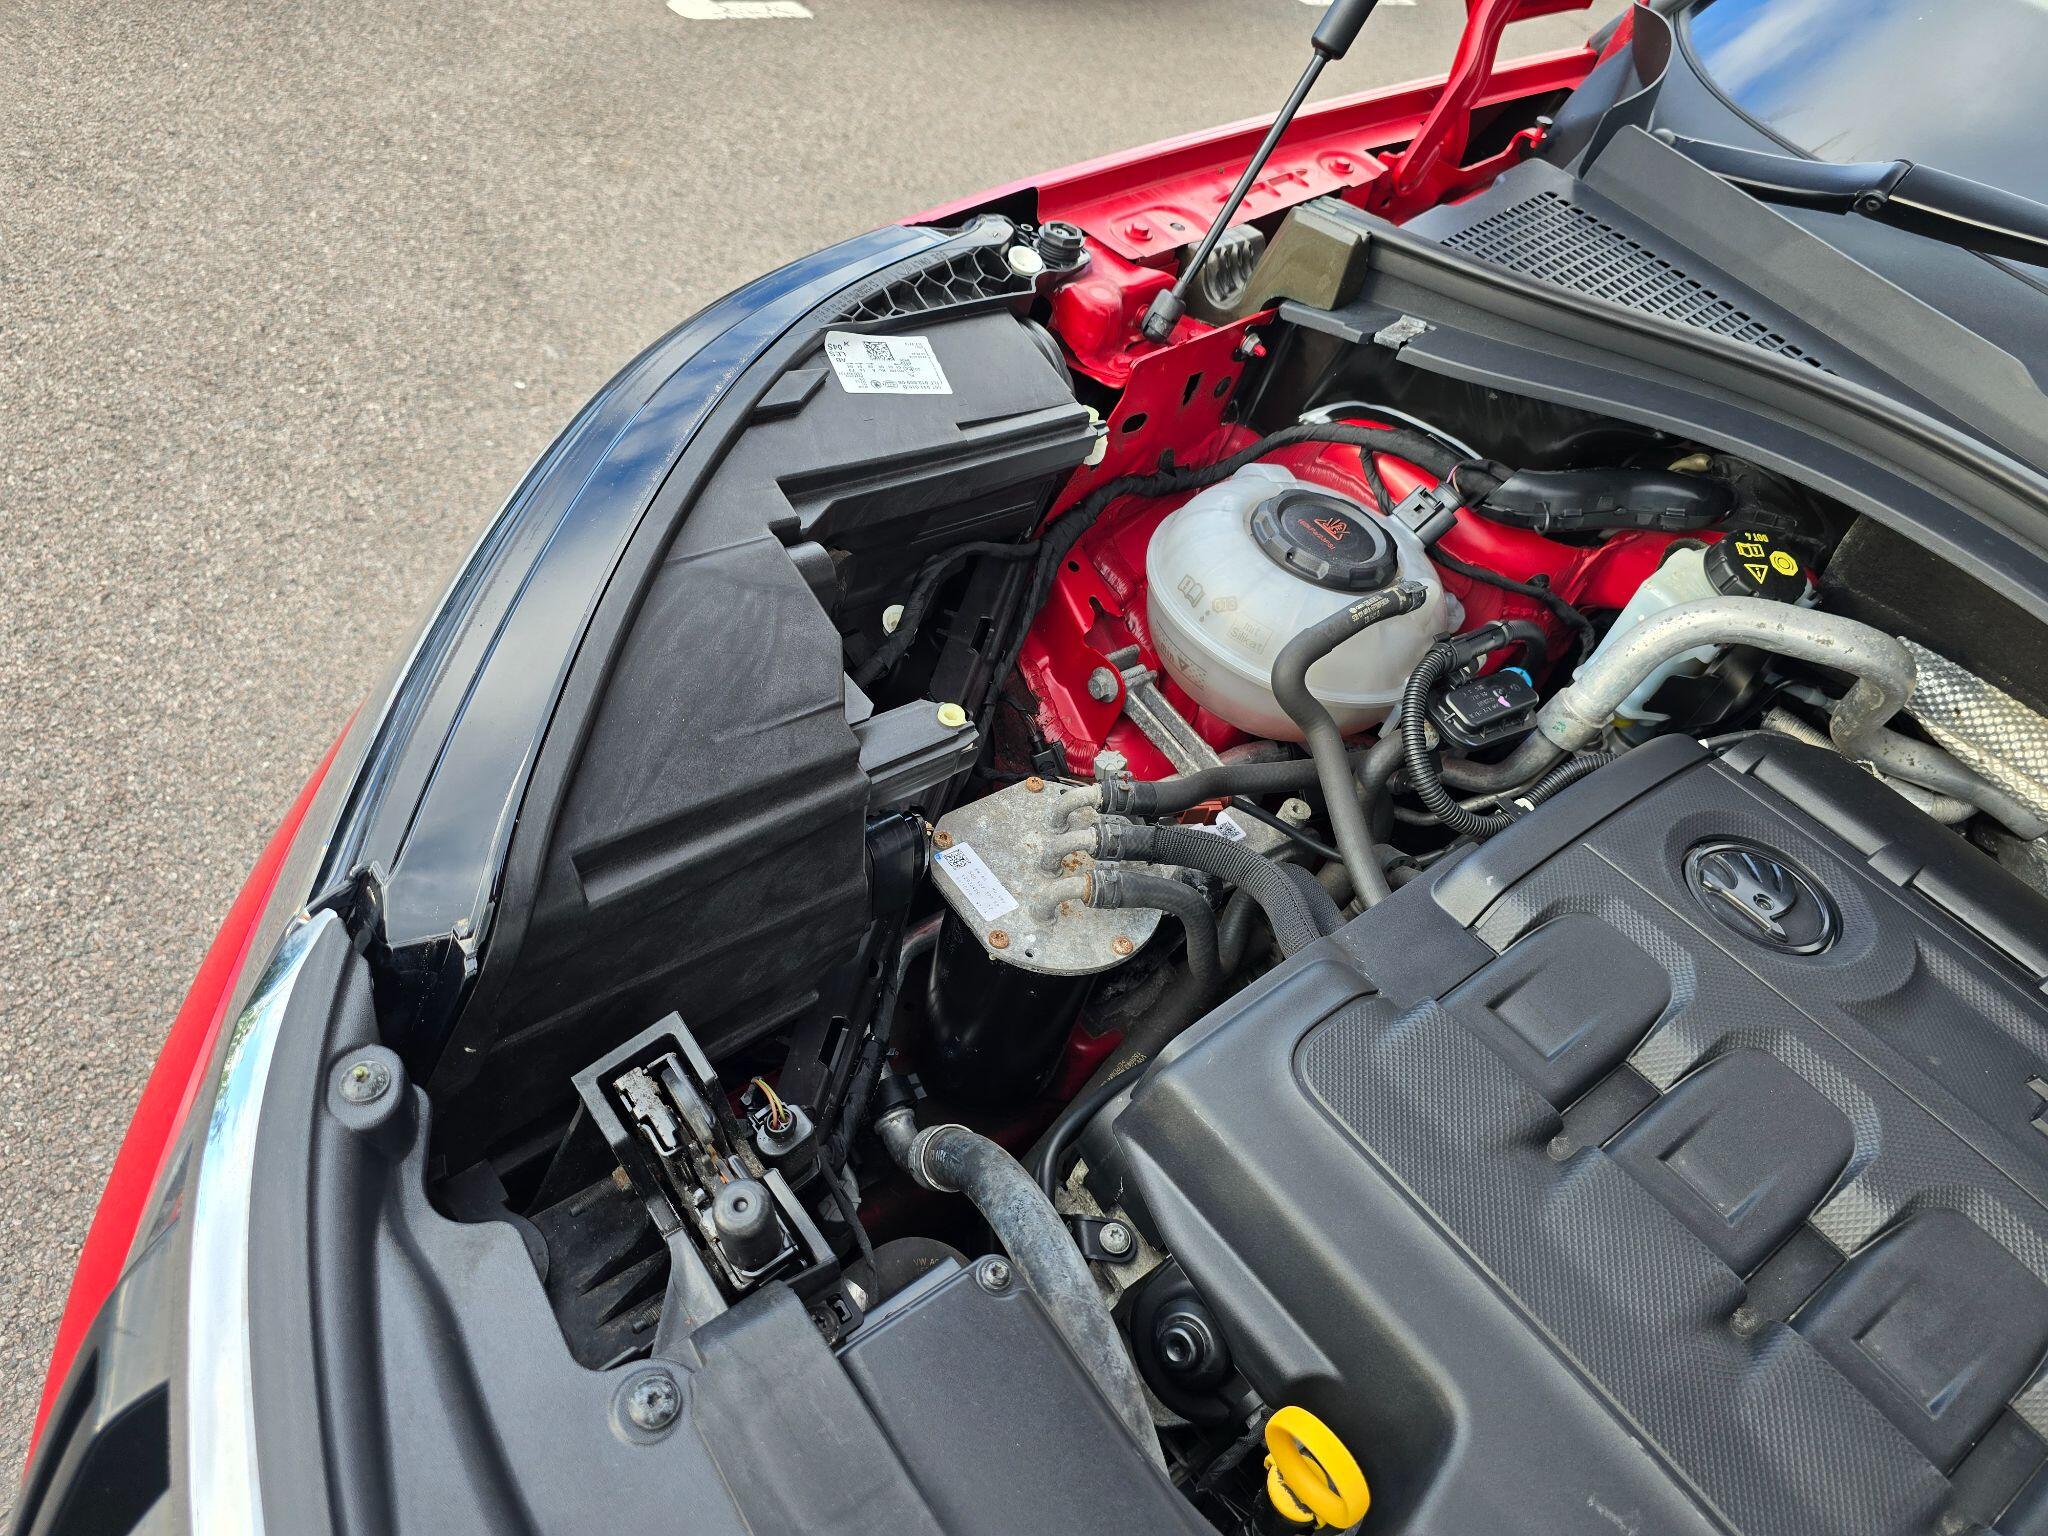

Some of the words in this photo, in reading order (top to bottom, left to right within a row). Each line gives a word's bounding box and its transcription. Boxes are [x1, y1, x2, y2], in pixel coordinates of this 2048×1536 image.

[1744, 532, 1752, 541] 4
[1753, 533, 1769, 543] DOT
[1230, 627, 1264, 653] Silikat
